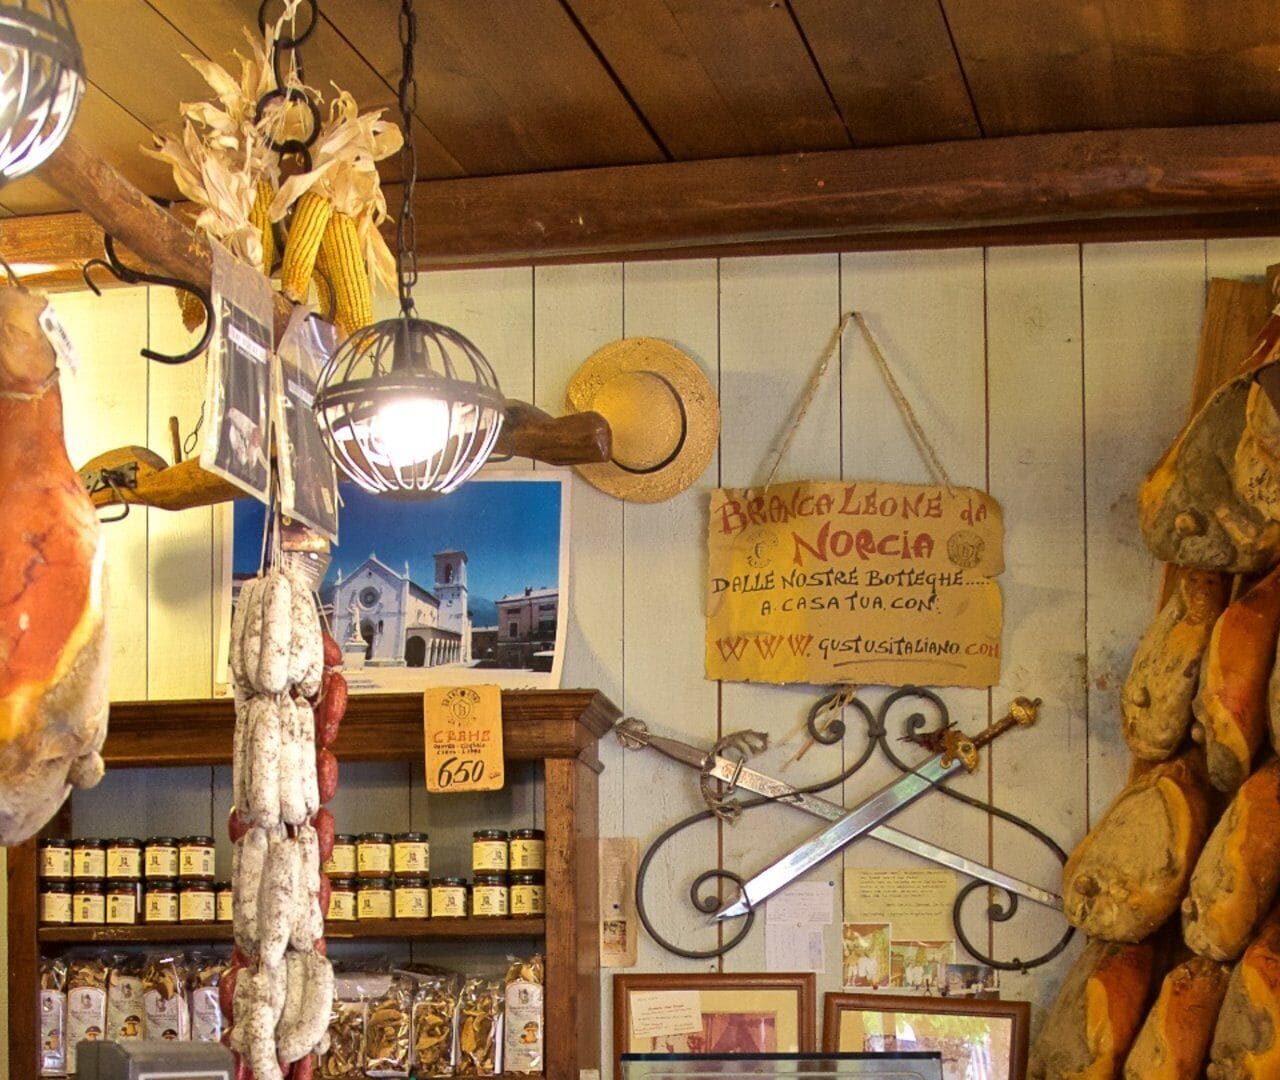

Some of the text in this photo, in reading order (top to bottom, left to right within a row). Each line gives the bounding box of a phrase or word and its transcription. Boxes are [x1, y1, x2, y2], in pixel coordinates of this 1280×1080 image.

[712, 570, 776, 594] DALLE
[781, 566, 859, 590] NOSTRE
[782, 596, 840, 611] CASA
